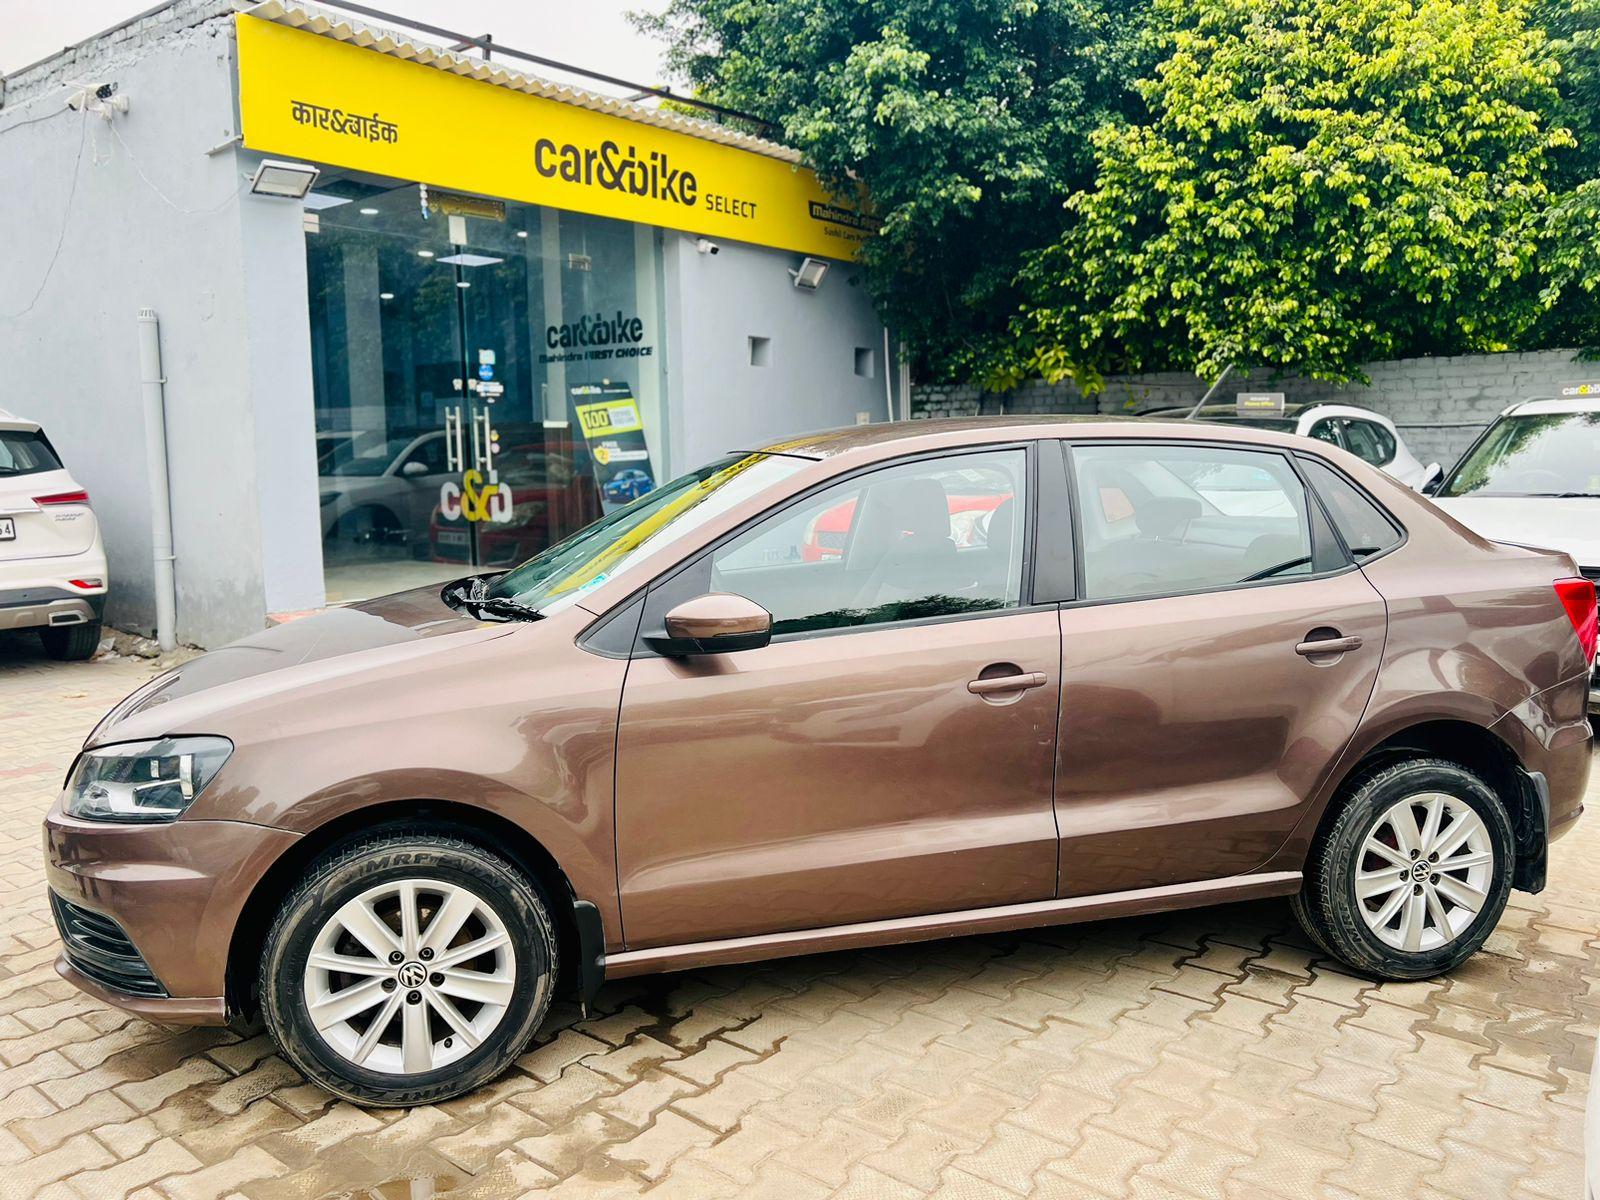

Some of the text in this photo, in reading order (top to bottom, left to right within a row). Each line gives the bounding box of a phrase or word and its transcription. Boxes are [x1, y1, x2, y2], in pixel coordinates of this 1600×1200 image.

[534, 138, 757, 219] car&bike SELECT
[546, 310, 643, 349] car&bike
[615, 346, 653, 359] CHOICE
